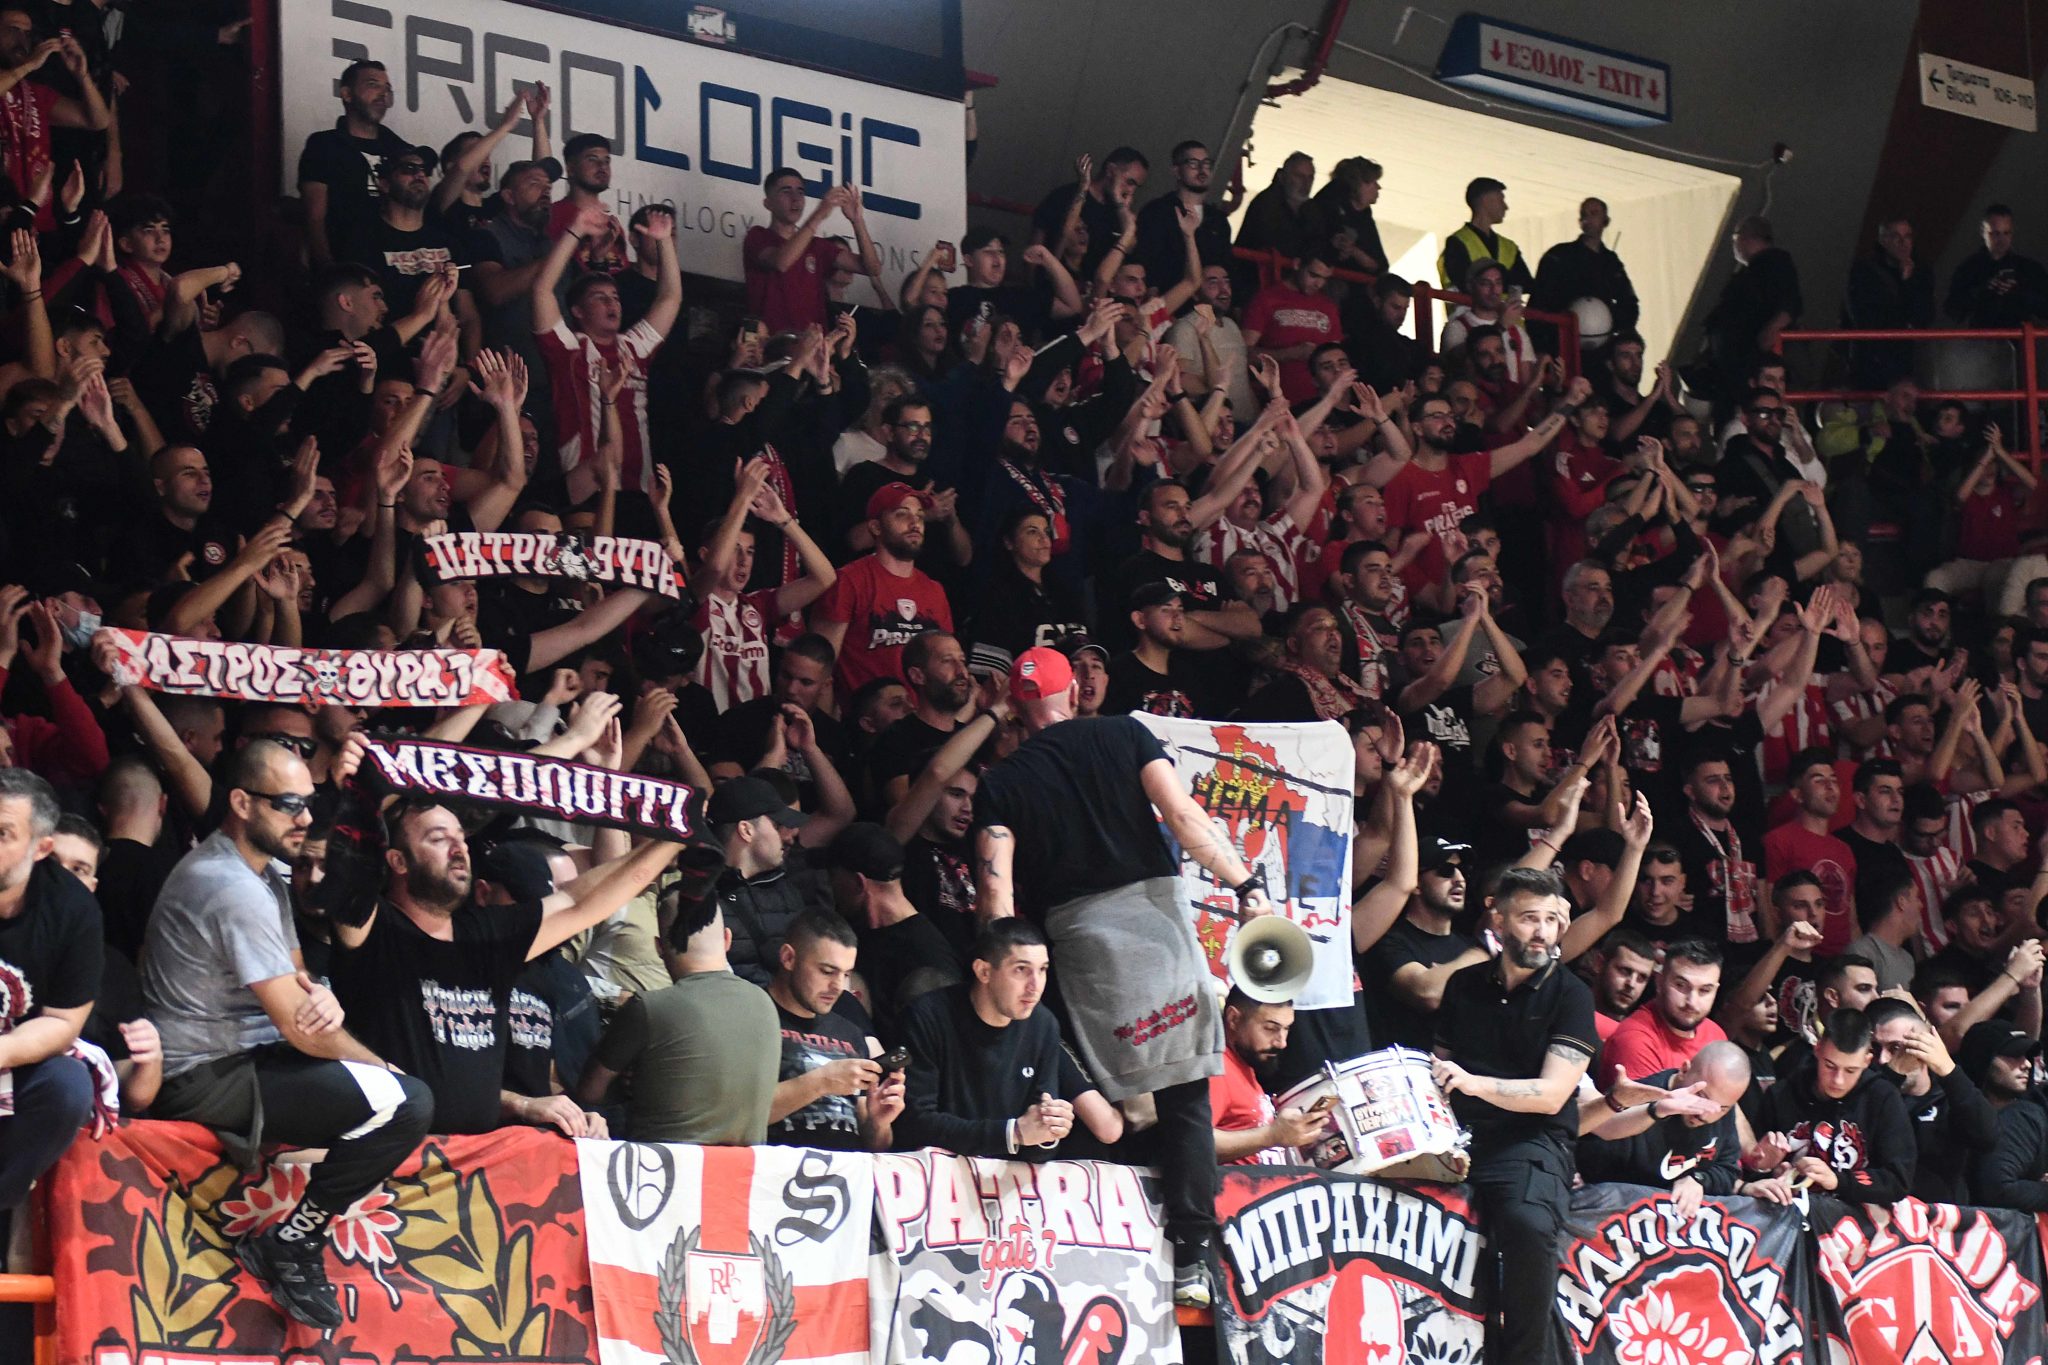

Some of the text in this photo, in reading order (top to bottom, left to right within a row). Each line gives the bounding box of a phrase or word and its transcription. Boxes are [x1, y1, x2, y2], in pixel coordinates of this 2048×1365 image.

[149, 636, 303, 698] ΑΣΤΡΟΣ
[345, 652, 446, 699] ΘΥΡΑ
[277, 1198, 330, 1243] BOS
[873, 1149, 1156, 1253] PATRA
[981, 1221, 1057, 1291] gate 7
[1223, 1181, 1487, 1300] ΜΠΡΑΧΑΜΙ
